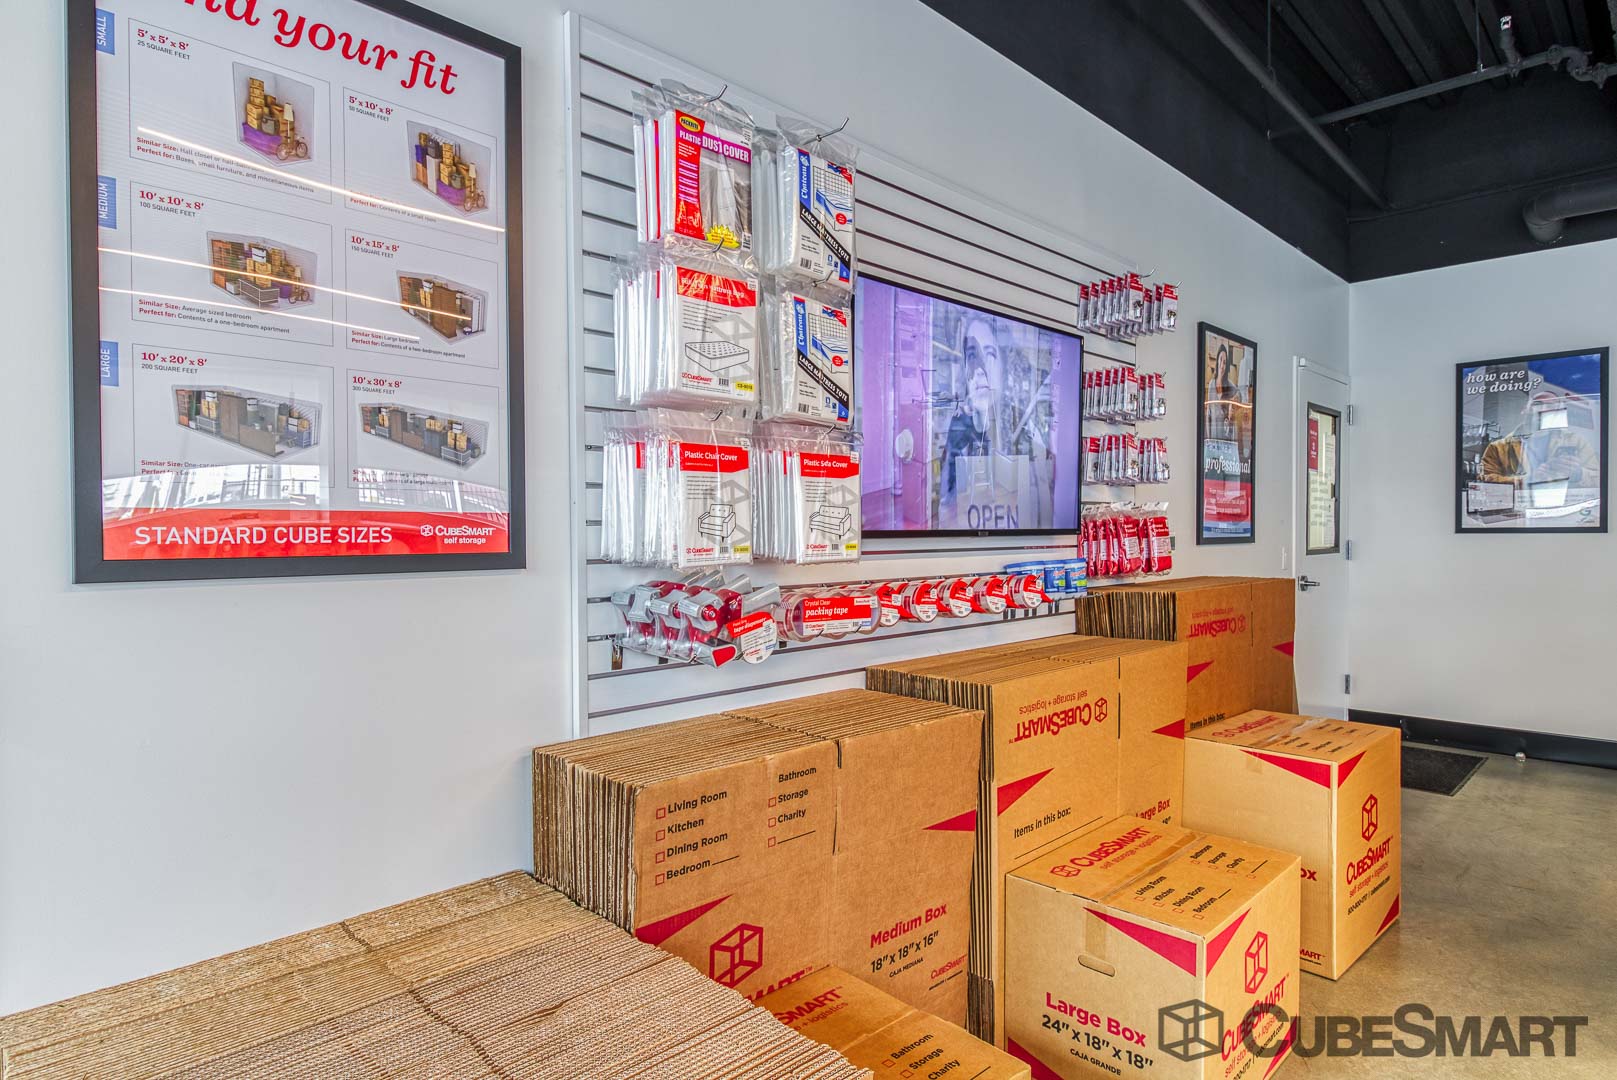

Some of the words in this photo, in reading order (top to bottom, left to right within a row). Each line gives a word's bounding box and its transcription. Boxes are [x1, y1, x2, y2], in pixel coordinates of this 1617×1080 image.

[96, 16, 107, 46] SMALL
[149, 34, 157, 42] x
[169, 40, 177, 48] x
[146, 42, 173, 56] SQUARE
[174, 50, 191, 60] FEET
[272, 8, 398, 71] your
[400, 50, 458, 95] fit
[356, 107, 376, 118] SQUARE
[377, 114, 390, 122] FEET
[136, 136, 161, 147] Similar
[136, 145, 162, 157] Perfect
[679, 130, 701, 145] PLASTIC
[702, 135, 723, 153] DUST
[723, 143, 749, 163] COVER
[98, 182, 108, 219] MEDIUM
[139, 190, 157, 200] 10'
[167, 196, 184, 206] 10'
[140, 201, 151, 209] 100
[151, 203, 179, 215] SQUARE
[179, 209, 196, 217] FEET
[801, 208, 818, 226] LARGE
[839, 247, 850, 262] TOTE
[360, 247, 381, 256] SQUARE
[381, 251, 394, 259] FEET
[138, 299, 163, 308] Similar
[164, 303, 181, 311] Size:
[181, 305, 207, 315] Average
[208, 309, 225, 318] sized
[225, 312, 252, 321] bedroom
[138, 307, 164, 317] Perfect
[164, 311, 177, 319] for:
[177, 313, 206, 323] Contents
[219, 319, 259, 330] one-bedroom
[260, 325, 290, 334] apartment
[351, 337, 372, 345] Perfect
[380, 342, 402, 350] Contents
[442, 351, 466, 359] apartment
[101, 348, 111, 378] LARGE
[141, 351, 159, 362] 10'
[169, 354, 188, 365] 20'
[153, 364, 181, 373] SQUARE
[182, 367, 198, 375] FEET
[799, 354, 814, 372] LARGE
[835, 387, 848, 402] TOTE
[1466, 372, 1497, 384] how
[1499, 370, 1525, 380] are
[352, 376, 366, 384] 10'
[373, 378, 387, 387] 30'
[1467, 385, 1486, 395] we
[1489, 377, 1542, 393] doing?
[141, 459, 166, 467] Similar
[684, 451, 705, 459] Plastic
[704, 452, 720, 460] Chair
[720, 453, 738, 461] Cover
[803, 458, 820, 467] Plastic
[1204, 455, 1251, 474] professional
[967, 504, 1019, 529] OPEN
[135, 526, 267, 545] STANDARD
[273, 526, 332, 544] CUBE
[337, 526, 393, 544] SIZES
[435, 525, 494, 537] CUBESMART
[444, 536, 458, 544] self
[458, 537, 486, 545] storage
[805, 607, 833, 618] packing
[833, 607, 849, 616] tape
[1053, 692, 1076, 706] storage
[1014, 703, 1092, 742] CUBESMART
[1190, 718, 1202, 730] Items
[1208, 714, 1216, 724] this
[778, 766, 817, 783] Bathroom
[667, 799, 698, 814] Living
[700, 790, 728, 805] Room
[777, 788, 809, 804] Storage
[1157, 799, 1171, 812] Box
[667, 817, 705, 834] Kitchen
[777, 808, 807, 824] Charity
[1014, 823, 1034, 839] Items
[1035, 818, 1043, 828] in
[1043, 812, 1056, 825] this
[1057, 806, 1072, 820] box:
[666, 840, 699, 858] Dining
[700, 832, 728, 848] Room
[1070, 827, 1151, 867] CUBESMART
[1190, 845, 1213, 859] Bathroom
[1207, 852, 1227, 864] Storage
[1346, 837, 1391, 885] CUBESMART
[666, 859, 711, 880] Bedroom
[1135, 883, 1155, 895] Living
[1149, 876, 1167, 887] Room
[1153, 888, 1175, 901] Kitchen
[1172, 895, 1194, 907] Dining
[1187, 886, 1205, 897] Room
[1192, 897, 1218, 913] Bedroom
[870, 916, 922, 949] Medium
[924, 904, 947, 924] Box
[889, 967, 902, 978] CAJA
[902, 957, 924, 972] MEDIANA
[807, 1002, 848, 1023] logistics
[1046, 992, 1101, 1028] Large
[1106, 1019, 1146, 1048] Box
[1221, 976, 1287, 1061] CUBESMART
[891, 1033, 934, 1060] Bathroom
[1041, 1014, 1070, 1034] 24"
[1072, 1029, 1081, 1042] x
[1084, 1029, 1110, 1052] 18"
[1112, 1047, 1122, 1059] x
[1126, 1048, 1154, 1070] 18"
[909, 1047, 944, 1071] Storage
[1070, 1048, 1091, 1065] CAJA
[1091, 1057, 1122, 1076] GRANDE
[928, 1059, 961, 1080] Charity
